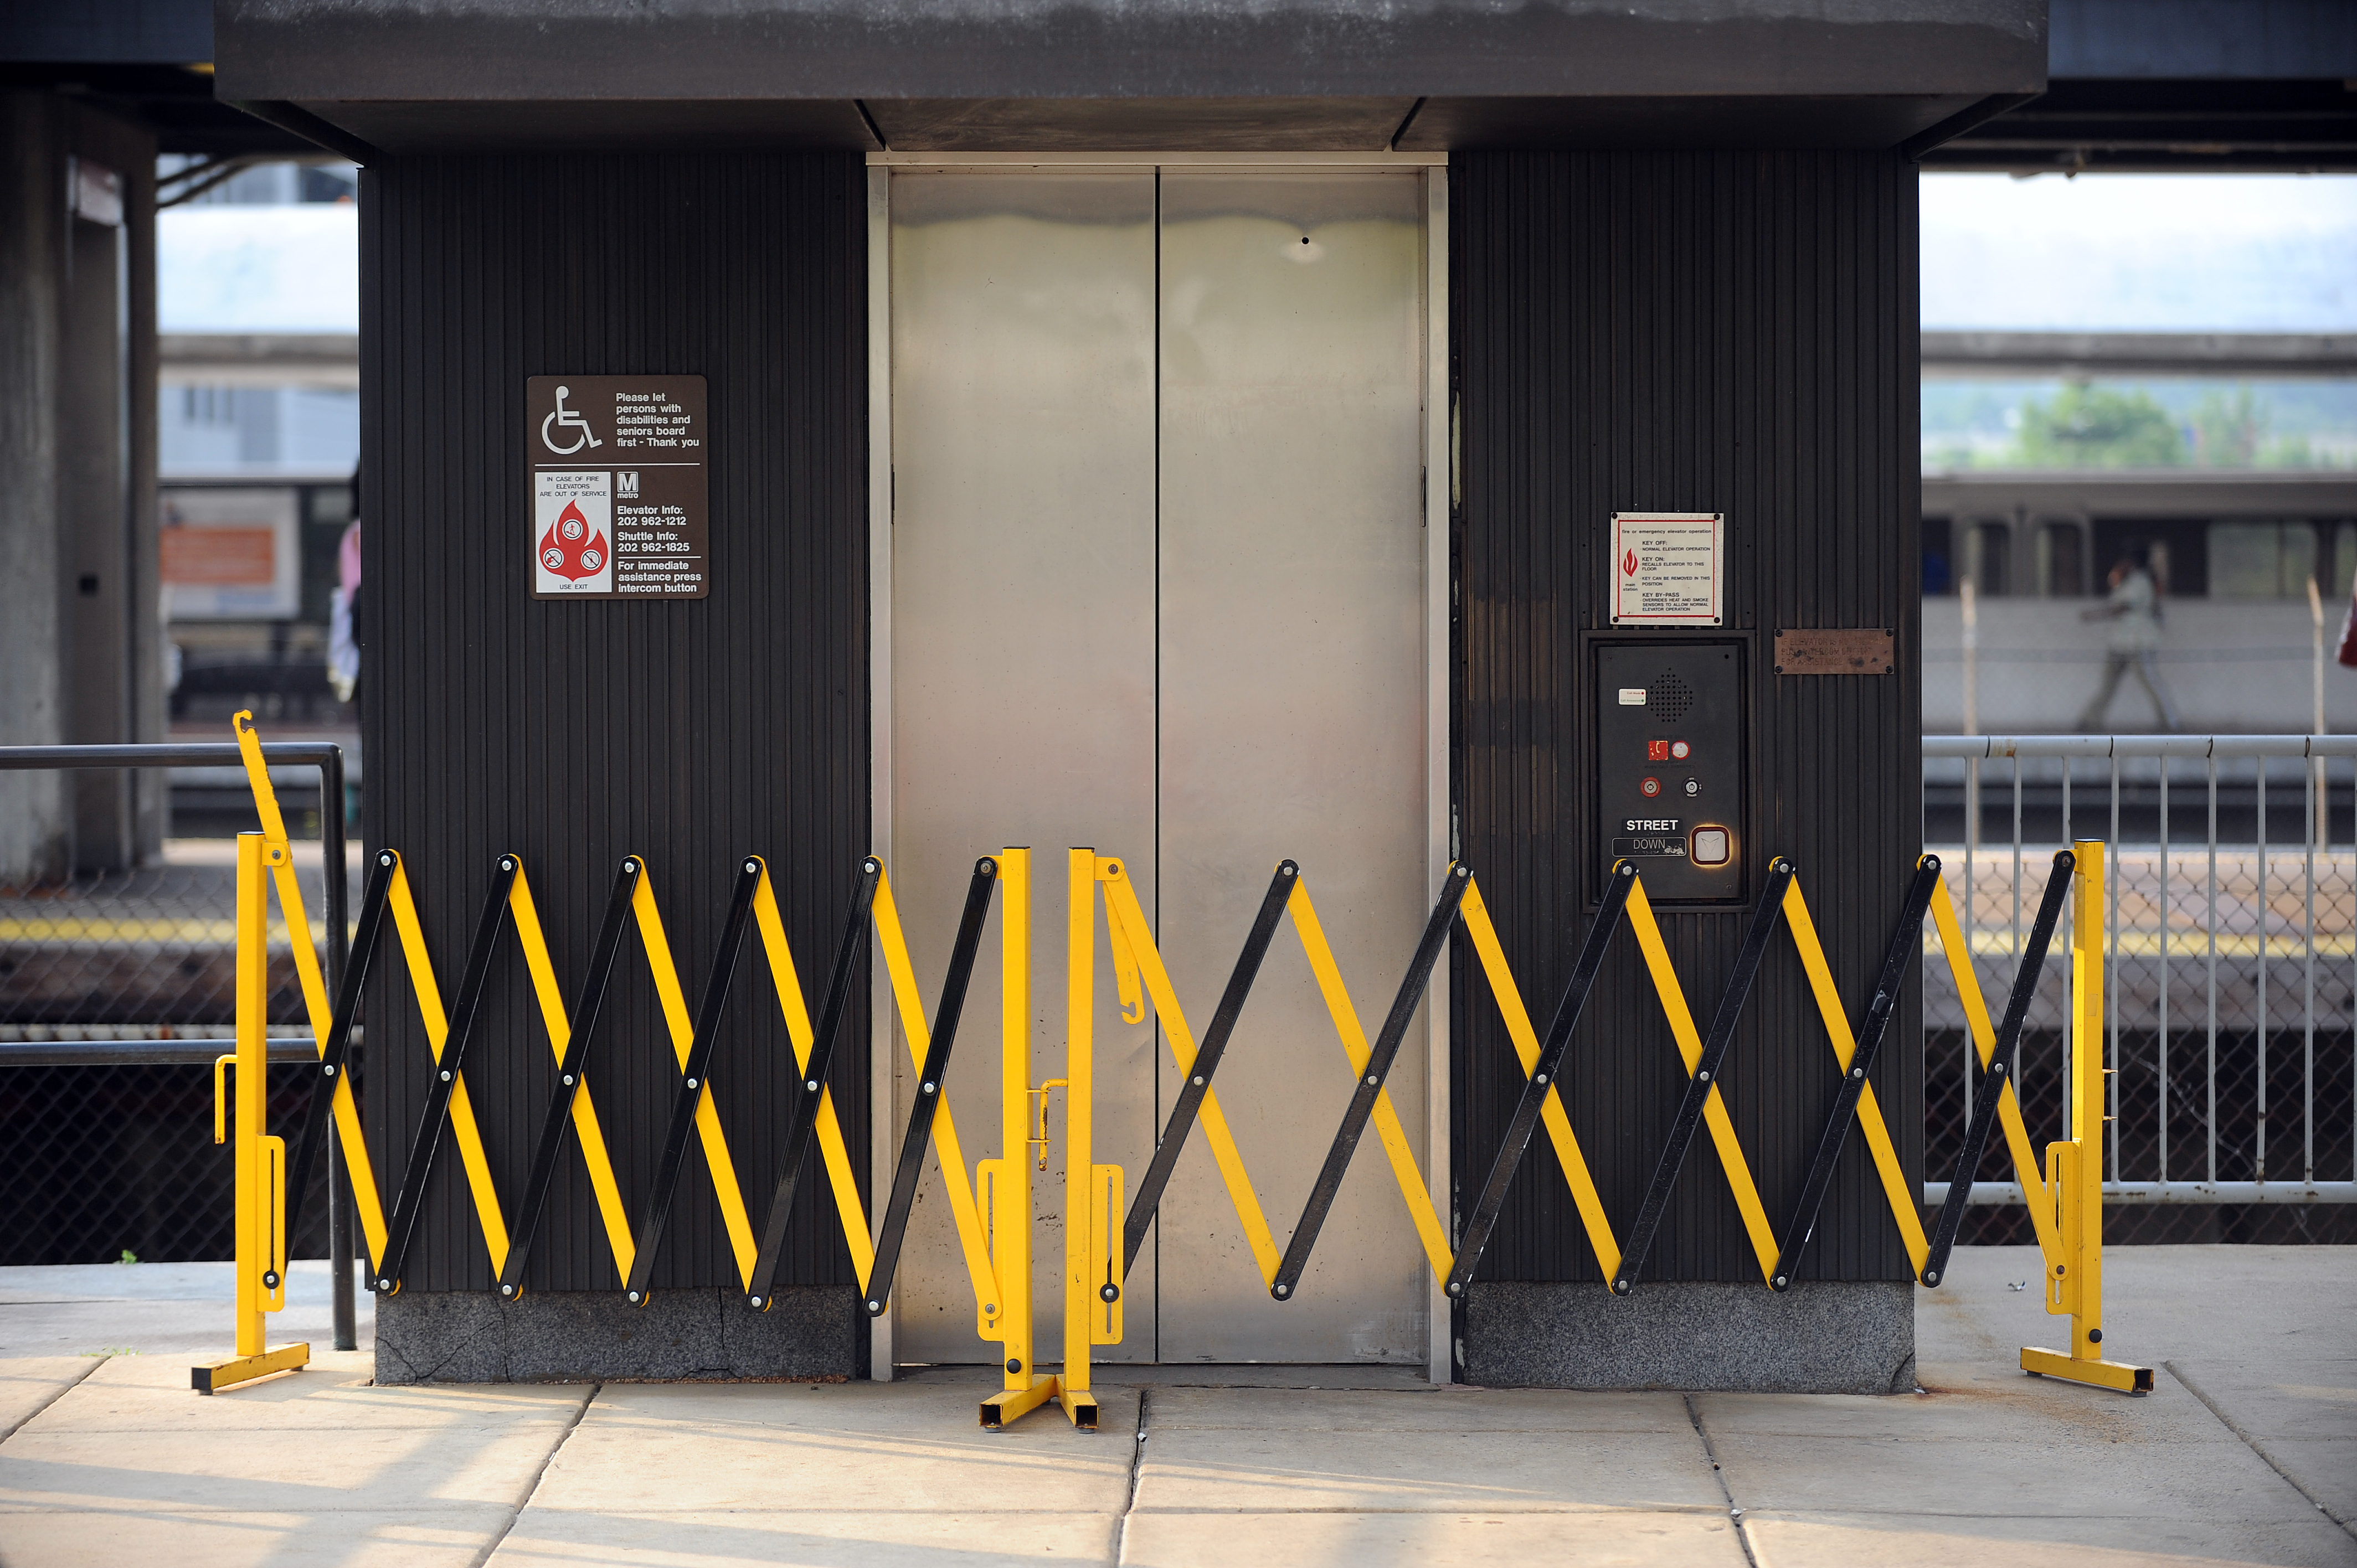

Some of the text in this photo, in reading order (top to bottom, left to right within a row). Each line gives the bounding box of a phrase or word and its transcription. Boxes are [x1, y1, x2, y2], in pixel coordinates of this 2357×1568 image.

[616, 393, 666, 401] Please let
[616, 404, 681, 415] persons with
[616, 415, 690, 424] disabilities and
[617, 426, 685, 436] seniors board
[617, 438, 637, 447] first
[646, 437, 677, 446] Thank
[681, 439, 699, 448] you
[619, 473, 636, 490] M
[617, 506, 683, 514] Elevator Info:
[617, 517, 686, 525] 202 962-1212
[617, 532, 678, 541] Shuttle Info:
[618, 543, 689, 552] 202 962-1825
[618, 561, 689, 570] For immediate
[618, 572, 702, 582] assistance press
[619, 583, 697, 592] intercom button
[1627, 820, 1678, 831] STREET
[1633, 839, 1665, 849] DOWN
